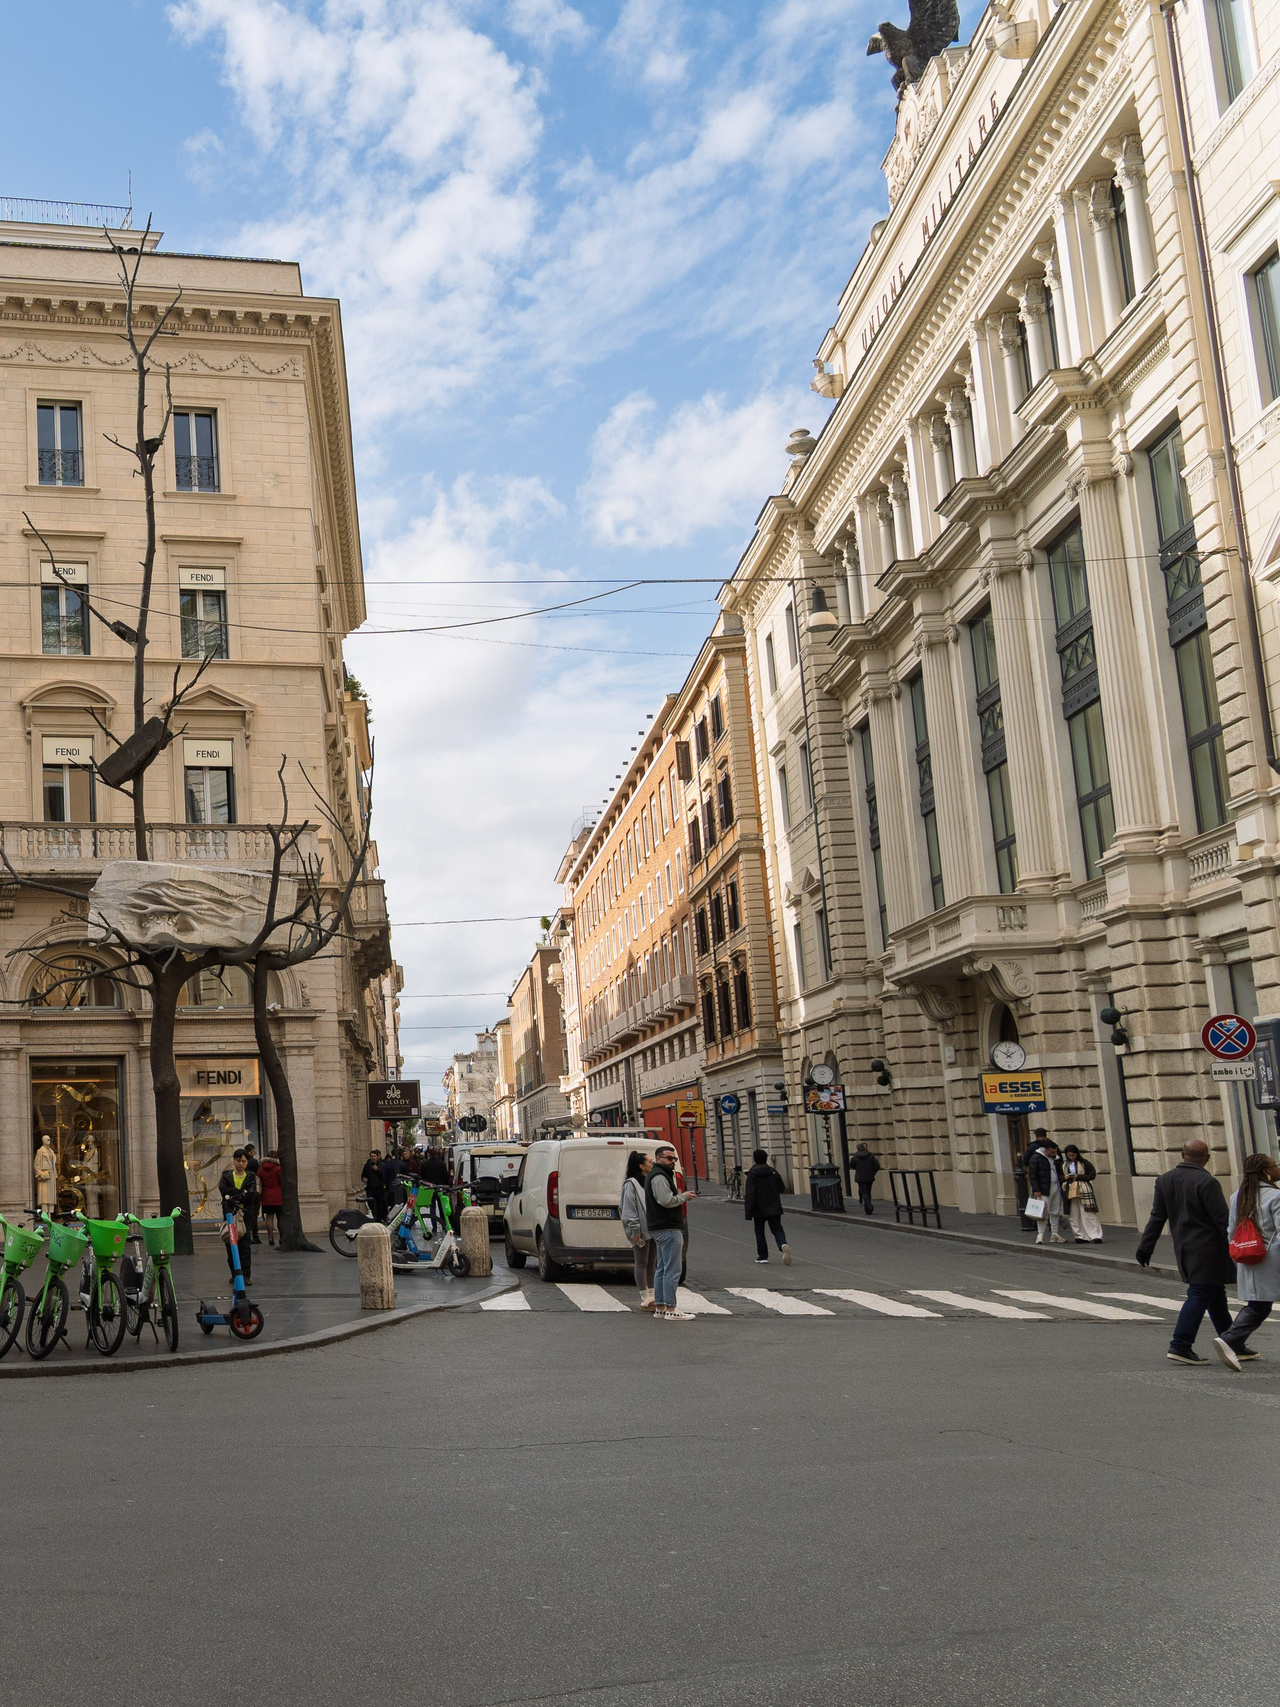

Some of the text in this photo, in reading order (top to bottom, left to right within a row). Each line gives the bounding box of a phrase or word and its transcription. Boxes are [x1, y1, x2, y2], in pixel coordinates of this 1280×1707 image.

[861, 90, 999, 351] UNIONE MILITARE
[190, 573, 214, 582] FENDI
[55, 748, 80, 756] FENDI
[196, 750, 220, 758] FENDI
[1213, 1067, 1233, 1075] ambo
[1235, 1067, 1238, 1075] i
[196, 1070, 242, 1085] FENDI
[576, 1209, 586, 1217] FE
